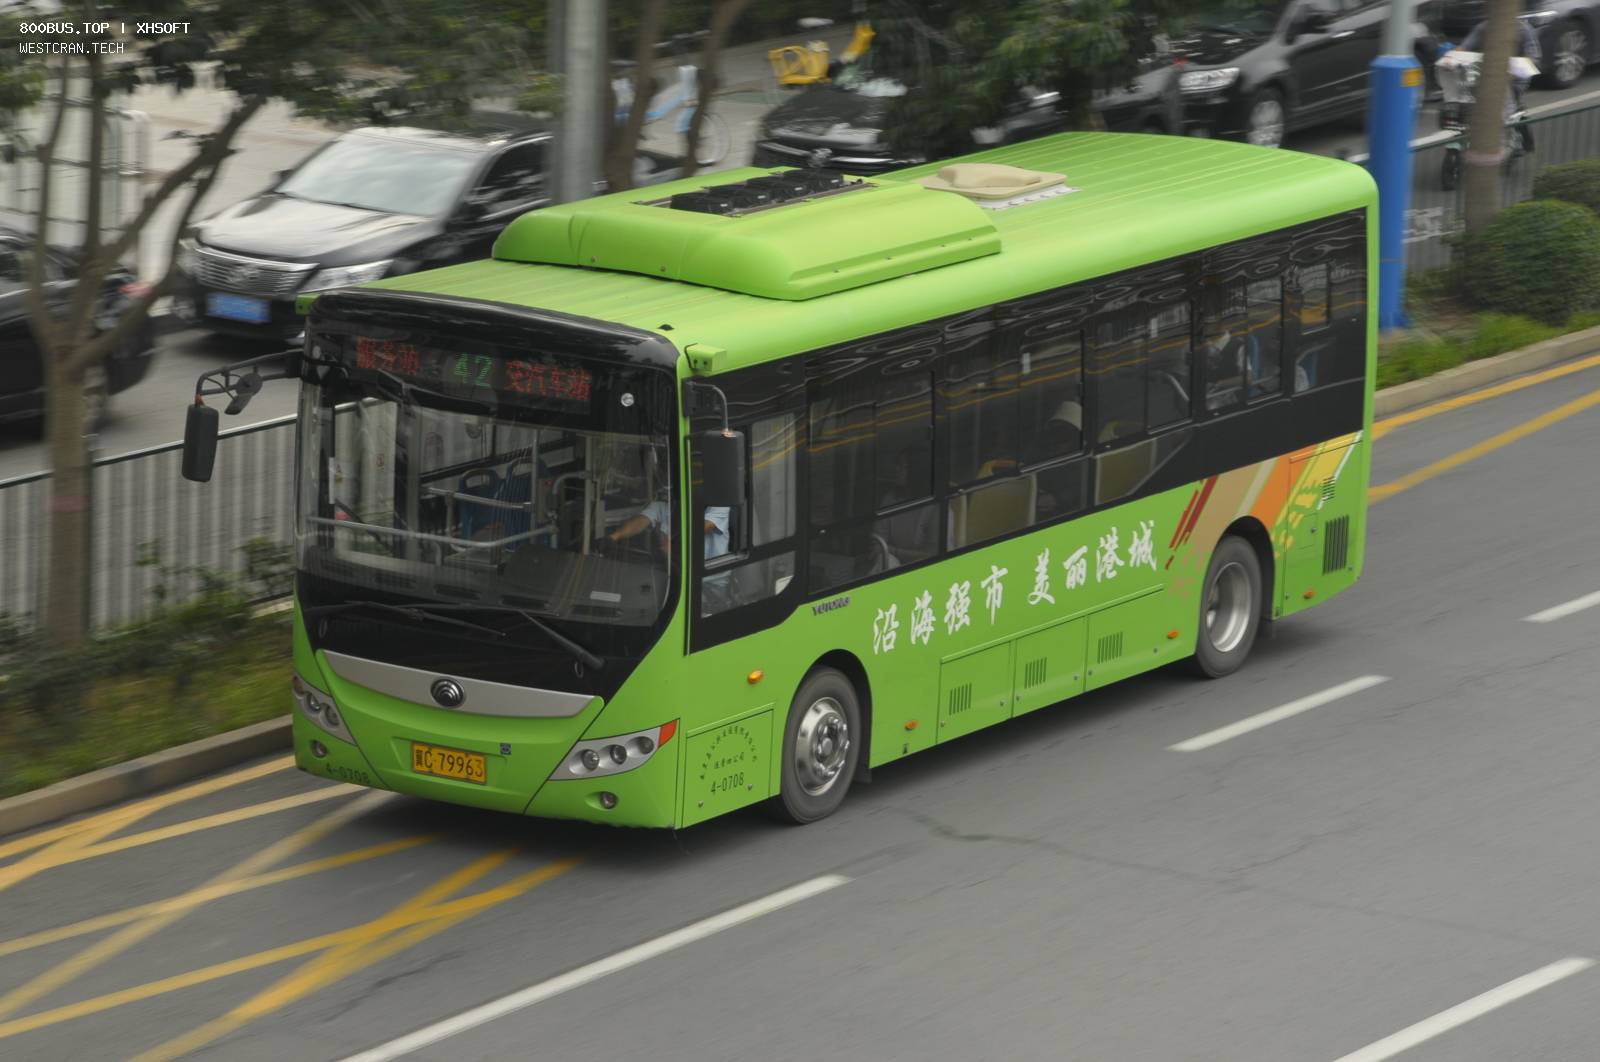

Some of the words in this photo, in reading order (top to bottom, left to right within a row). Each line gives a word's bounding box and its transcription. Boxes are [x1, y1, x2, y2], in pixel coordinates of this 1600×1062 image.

[453, 352, 494, 388] 42
[873, 565, 1008, 655] 沿海强市
[1027, 520, 1157, 605] 美丽港城
[711, 772, 745, 795] 4-0708
